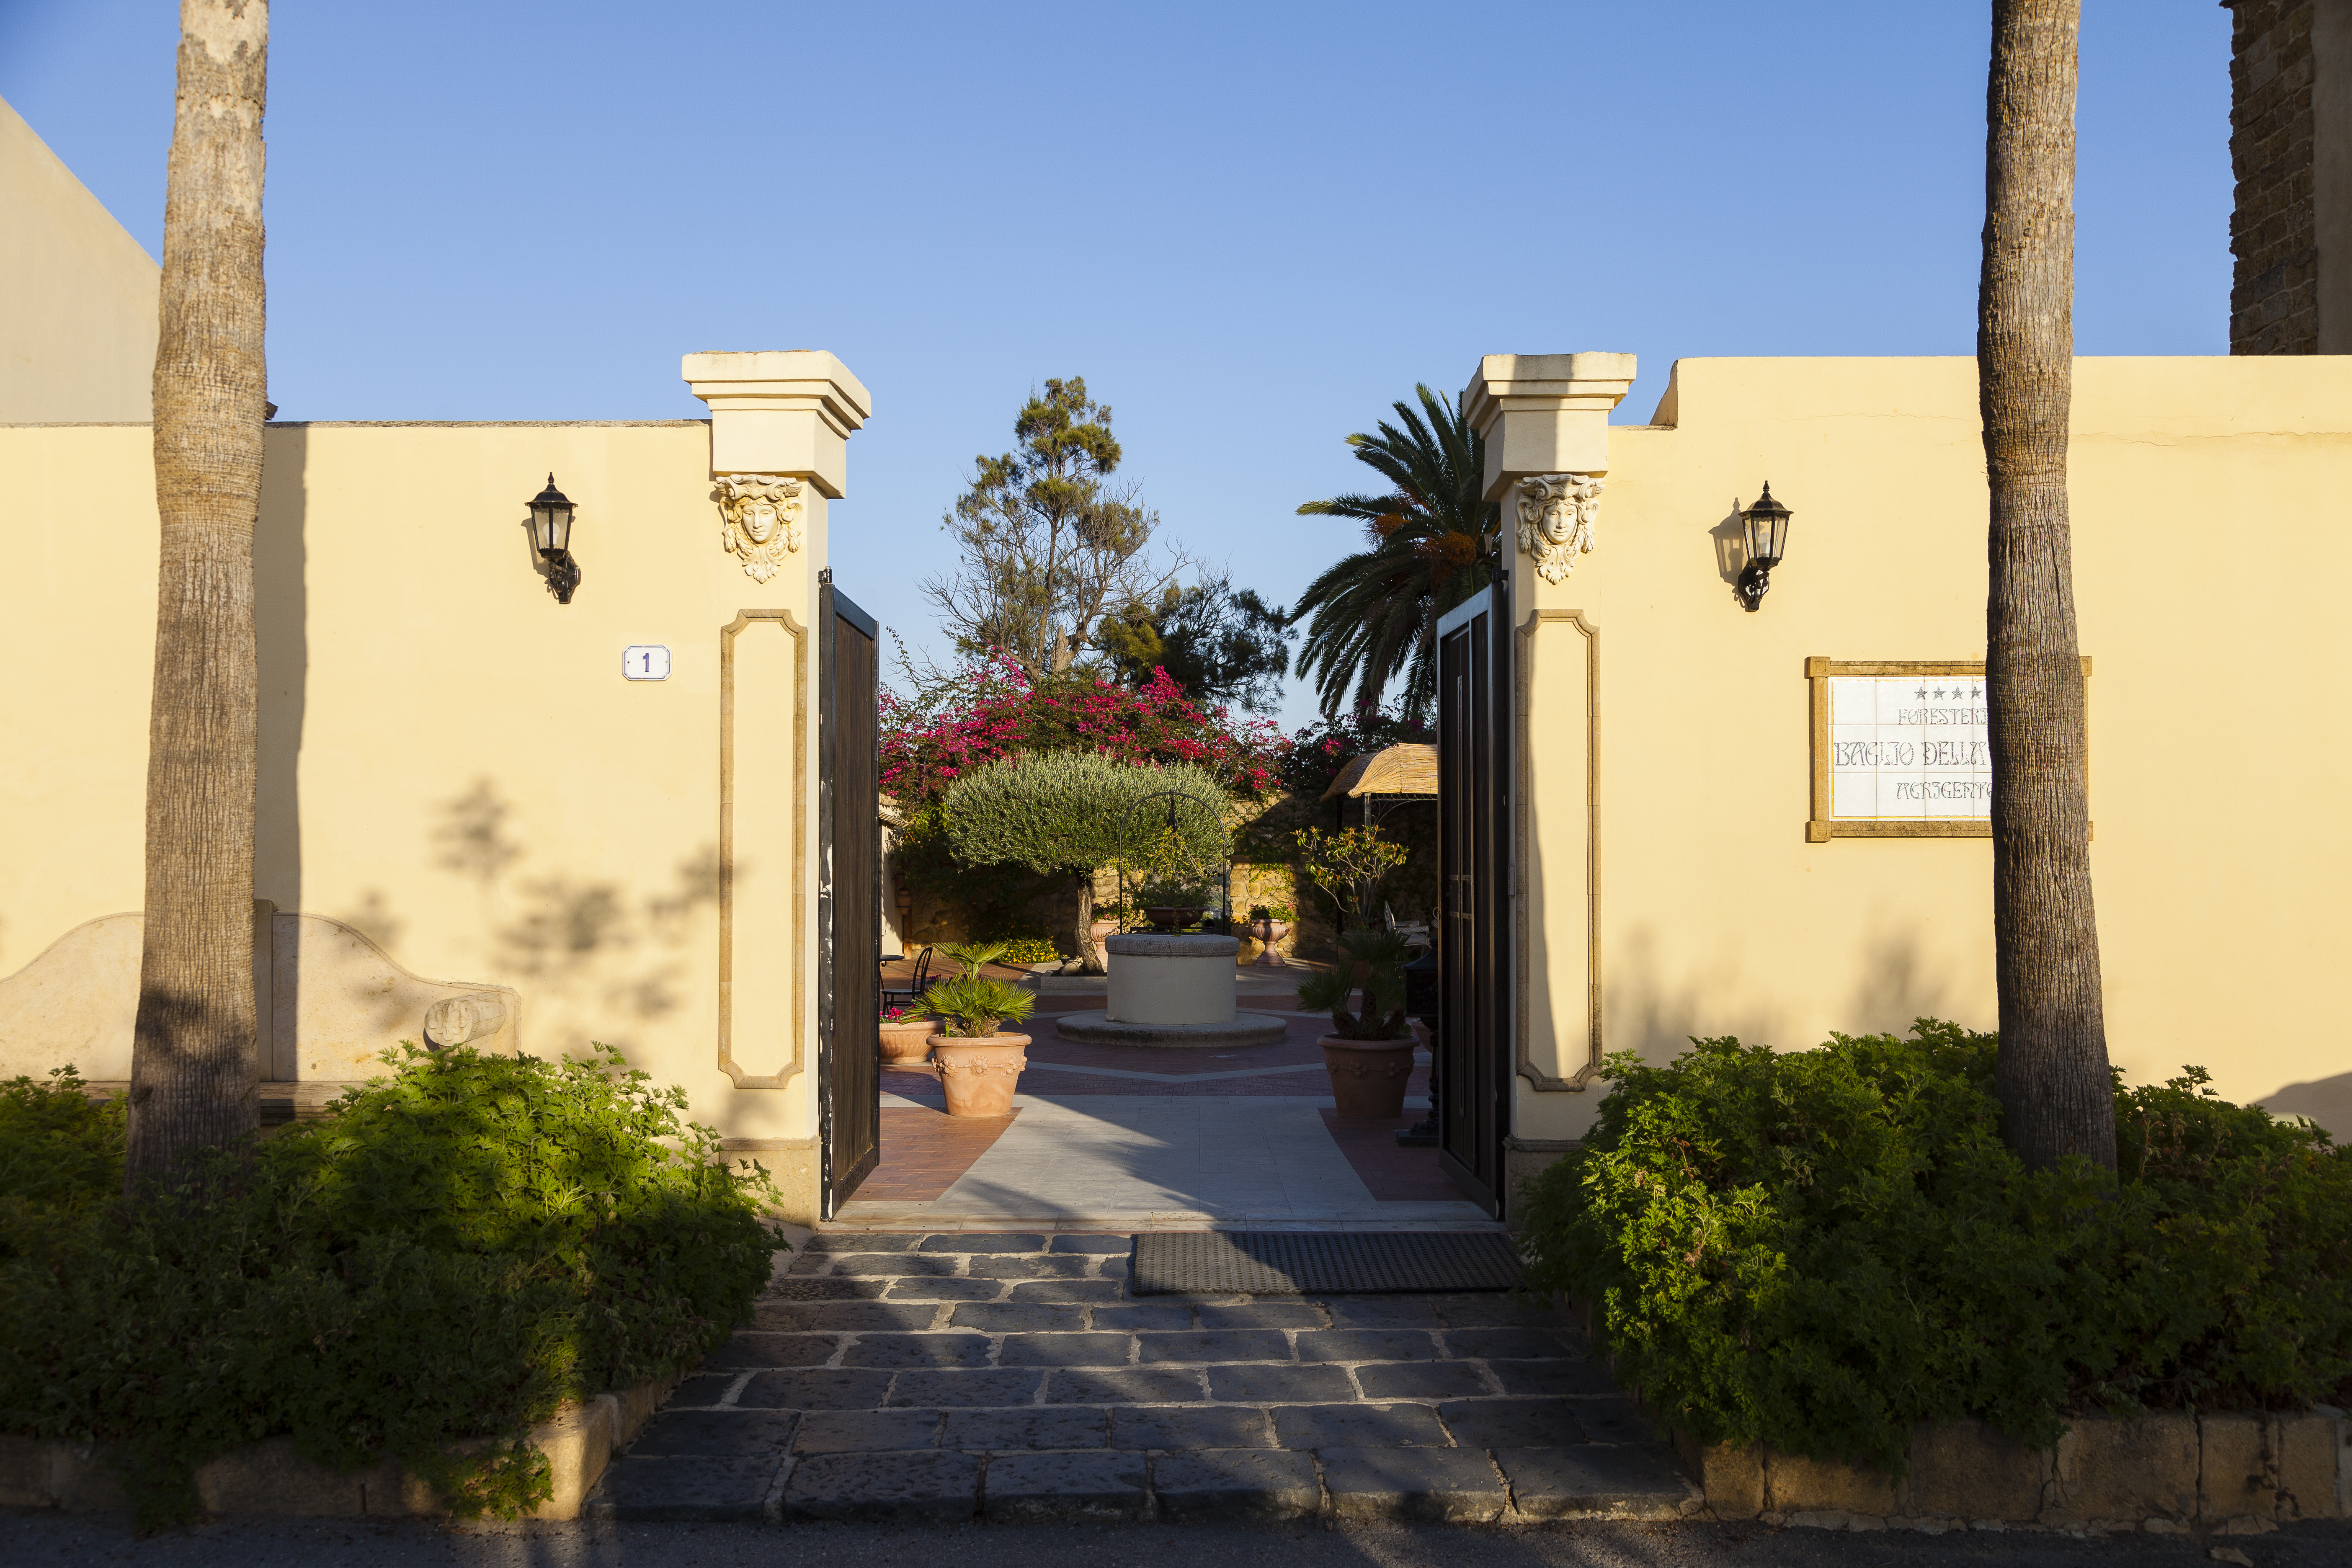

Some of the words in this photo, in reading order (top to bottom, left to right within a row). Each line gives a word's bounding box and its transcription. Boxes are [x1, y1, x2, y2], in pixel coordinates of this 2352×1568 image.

[642, 653, 649, 672] 1
[1834, 742, 1914, 766] BAGLIO
[1921, 741, 1986, 766] DELLA
